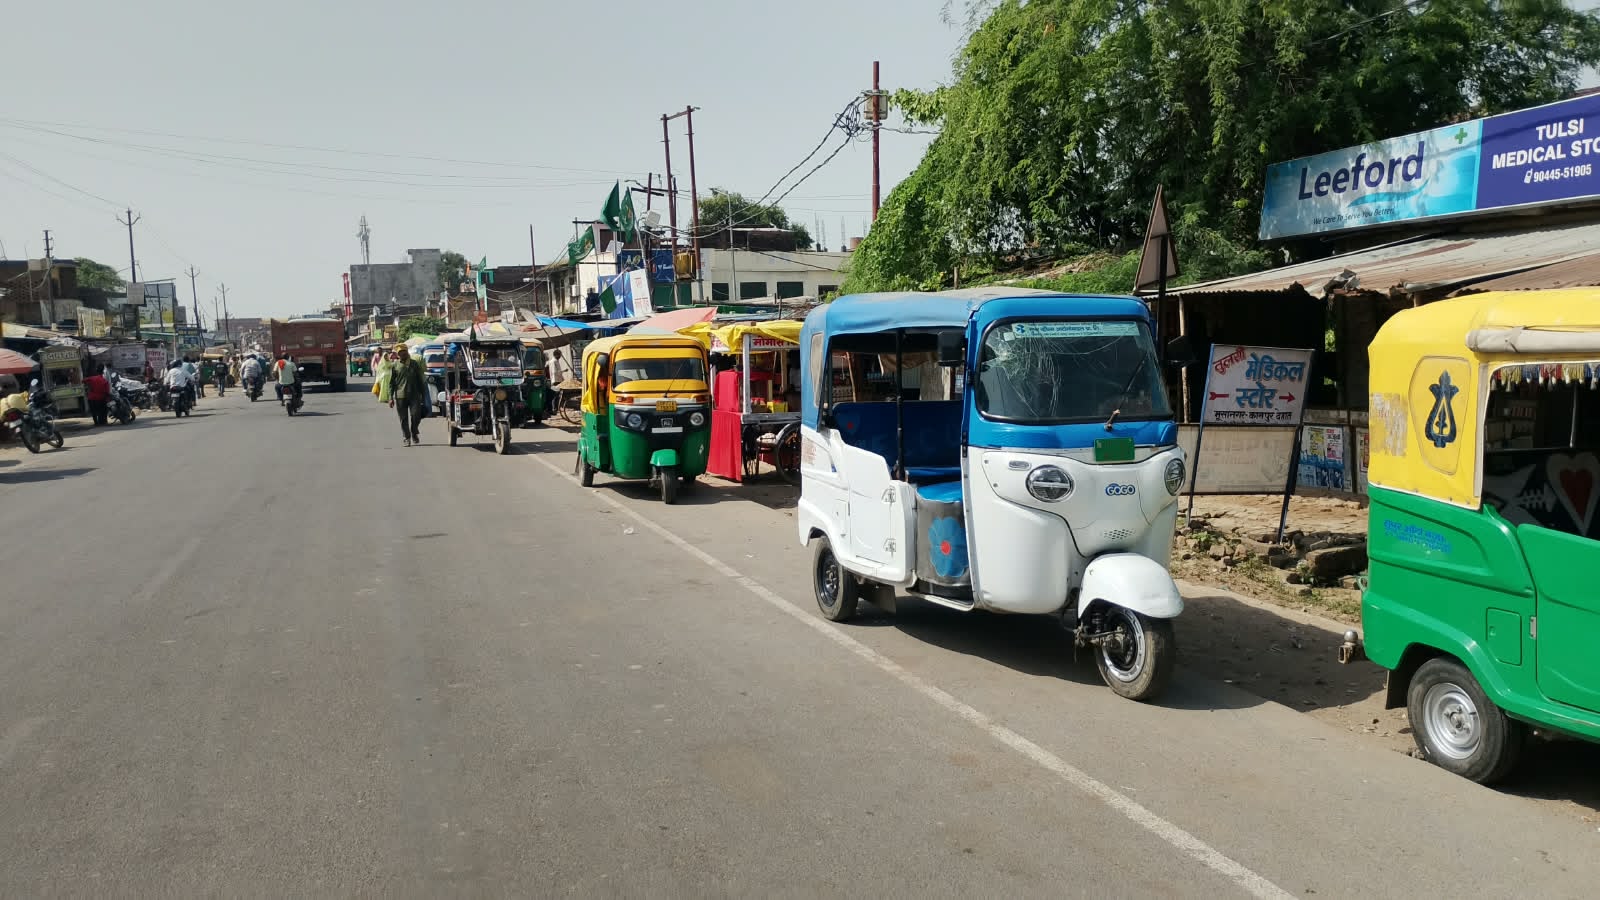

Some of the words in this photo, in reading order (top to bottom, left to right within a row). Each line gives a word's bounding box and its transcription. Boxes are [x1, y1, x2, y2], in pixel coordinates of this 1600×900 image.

[1535, 118, 1584, 141] TULSI
[1492, 143, 1566, 169] MEDICAL
[1299, 141, 1425, 200] Leeford
[1533, 163, 1592, 182] 90445-51905
[1322, 216, 1336, 224] Care
[1213, 347, 1246, 375] तुलसी
[1246, 353, 1305, 381] मेडिकल
[1236, 382, 1277, 408] स्टोर
[1105, 483, 1136, 496] GOGO
